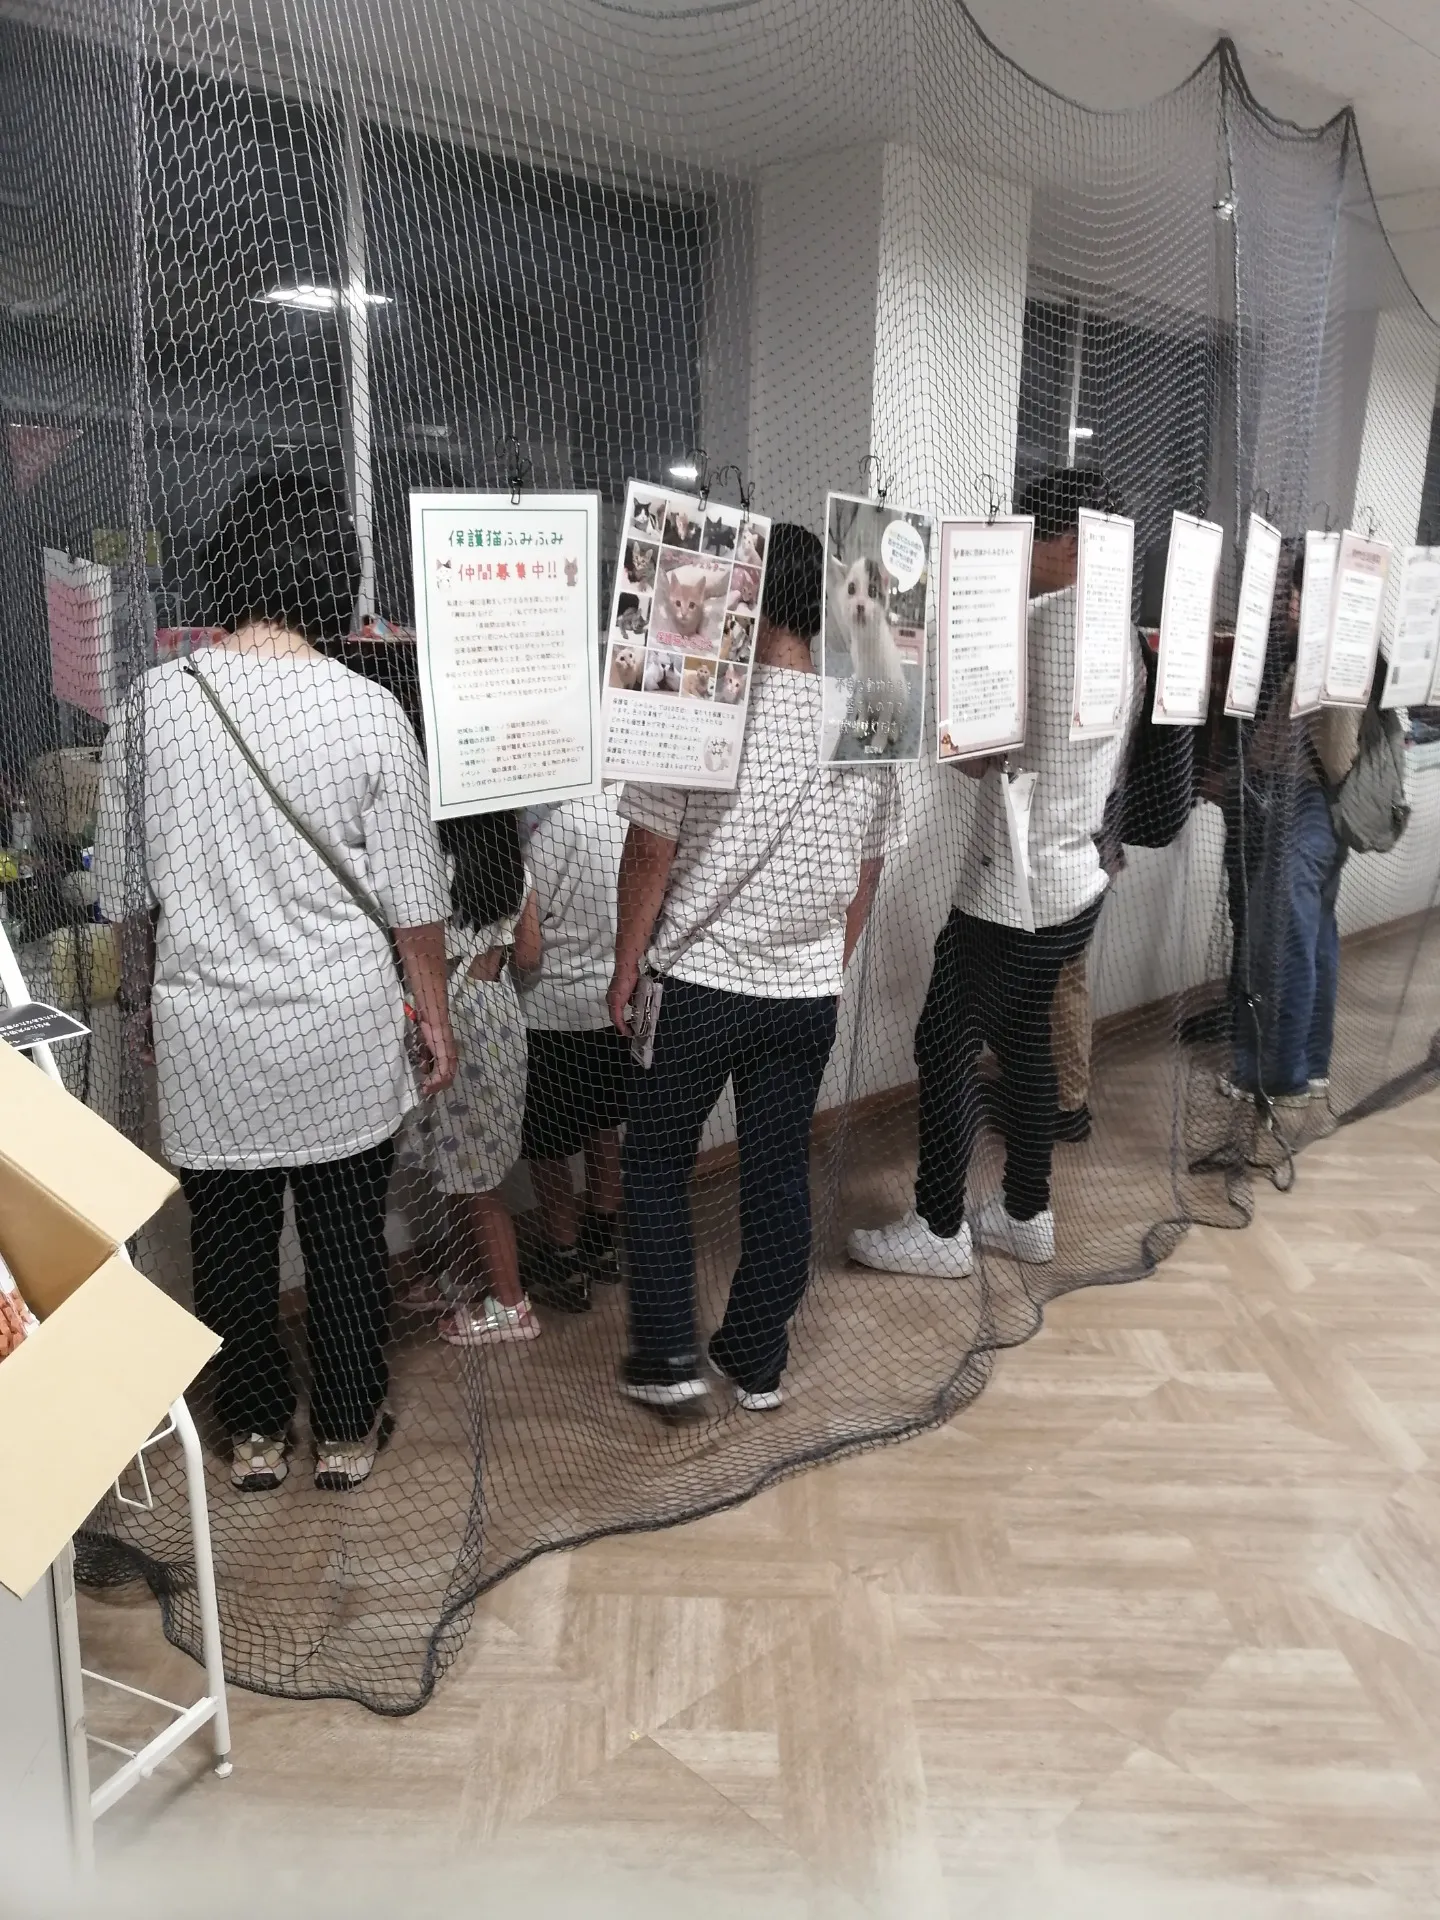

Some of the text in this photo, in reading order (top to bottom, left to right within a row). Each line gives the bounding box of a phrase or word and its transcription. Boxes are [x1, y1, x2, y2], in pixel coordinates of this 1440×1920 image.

[448, 529, 564, 547] 保護猫ふみふみ
